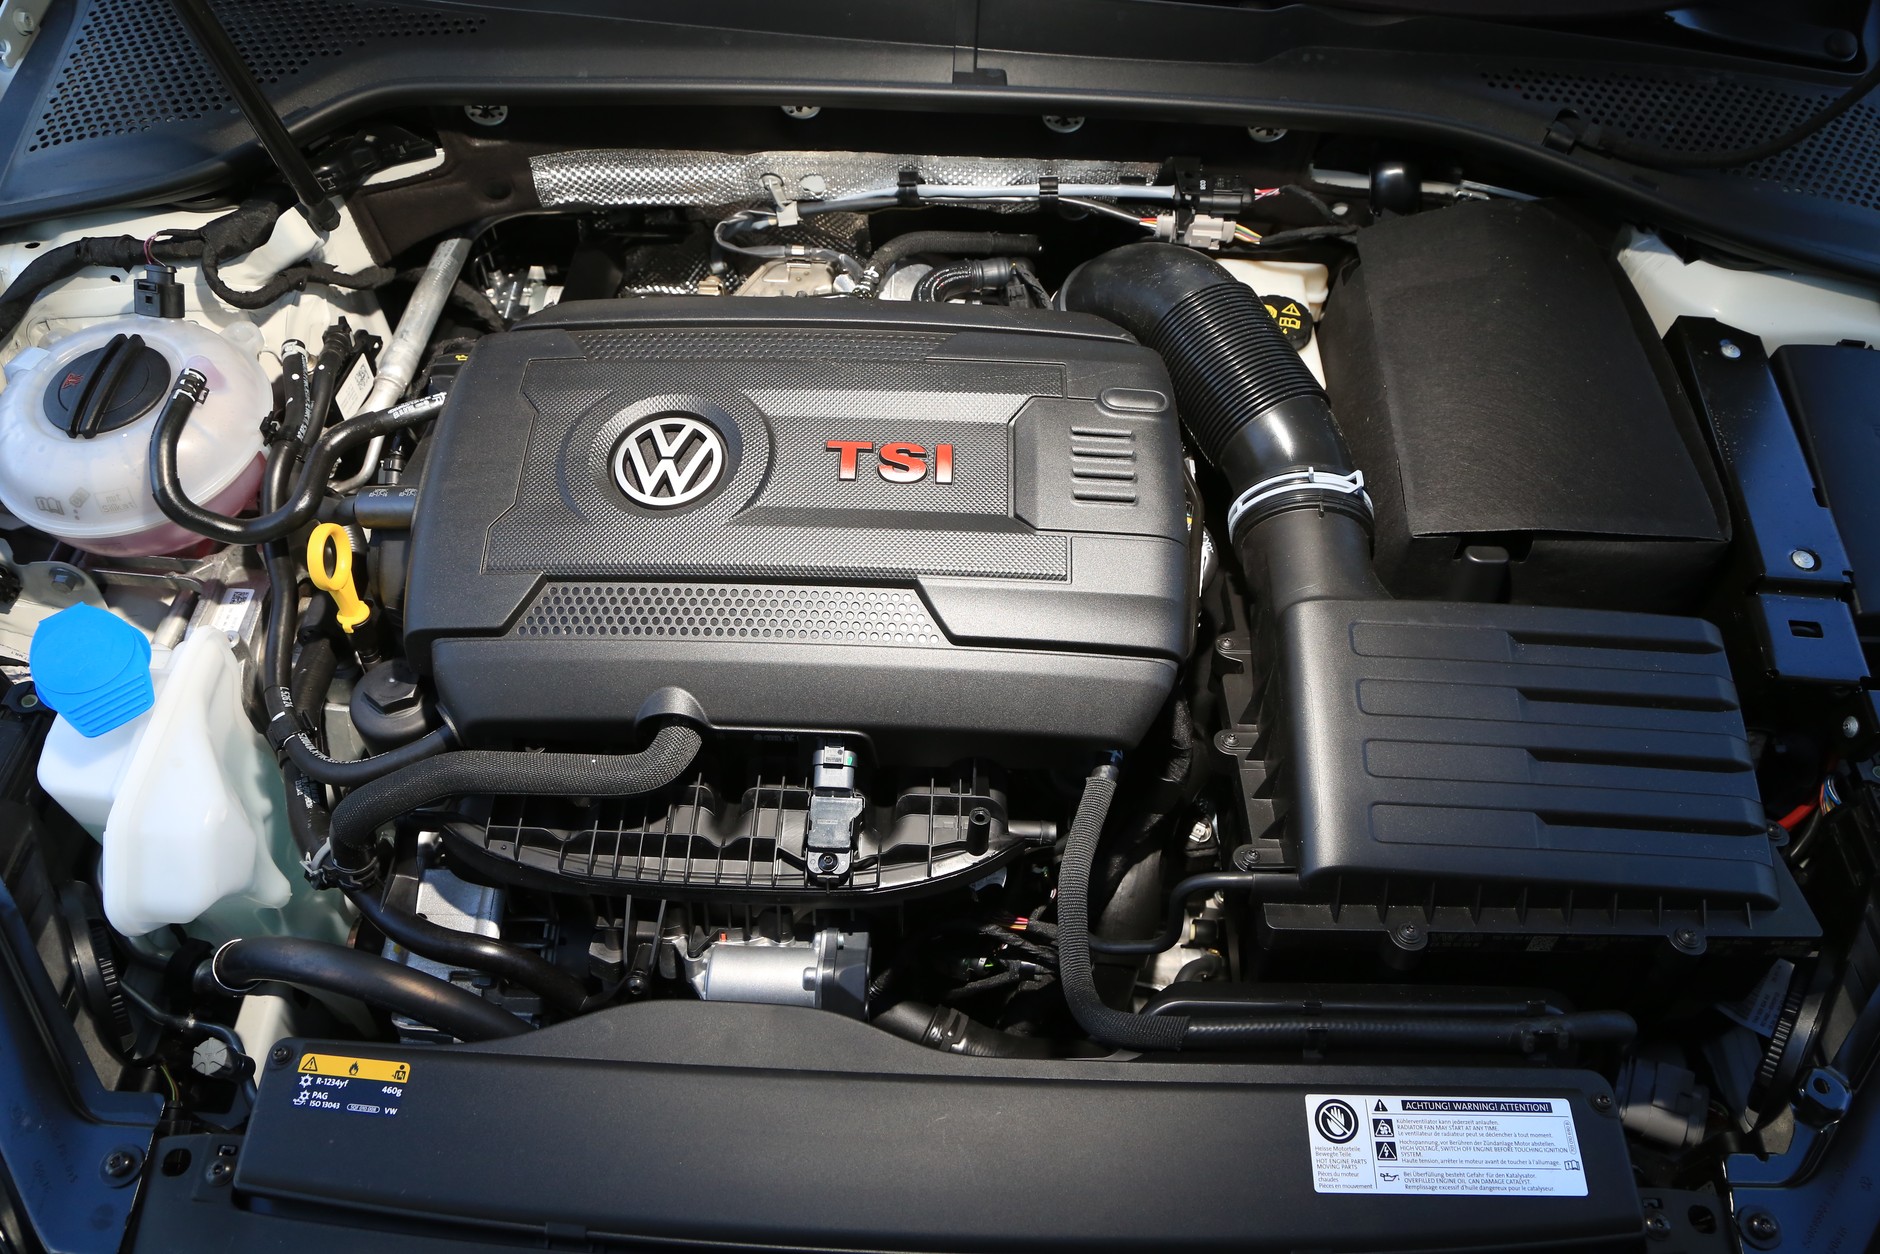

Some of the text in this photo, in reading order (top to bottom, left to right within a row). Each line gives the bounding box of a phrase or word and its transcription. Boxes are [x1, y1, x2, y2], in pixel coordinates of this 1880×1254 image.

[614, 417, 723, 506] VW
[825, 440, 955, 485] TSI
[316, 1077, 402, 1097] R-1234yf 460g
[312, 1091, 328, 1100] PAG
[322, 1100, 340, 1109] 13043
[1406, 1102, 1549, 1112] ACHTUNG! WARNING! ATTENTION!
